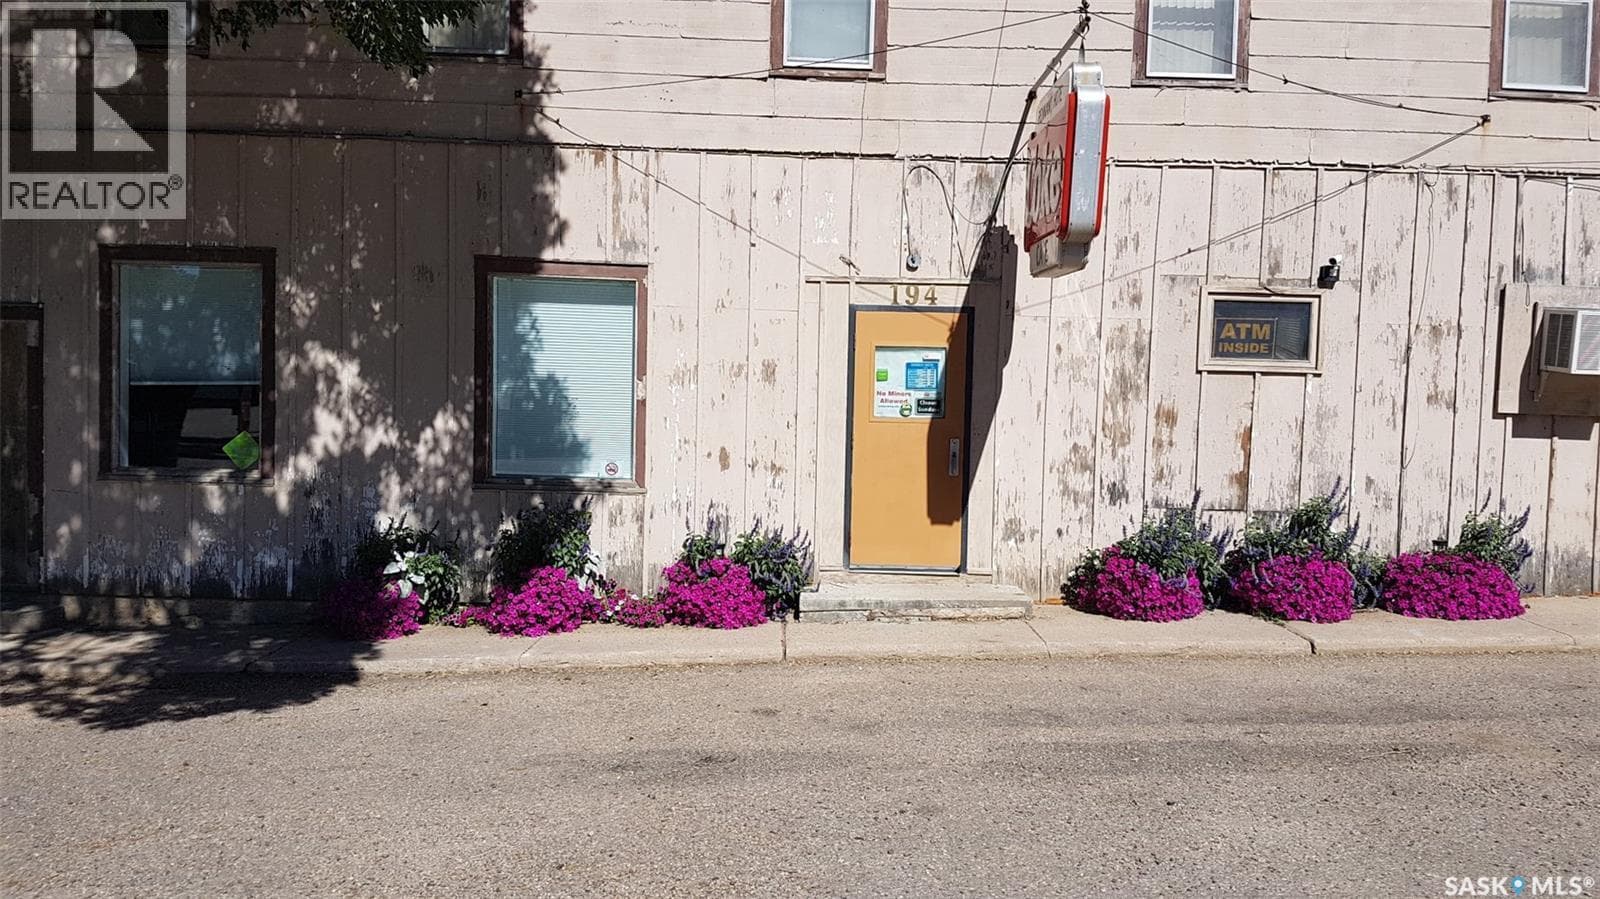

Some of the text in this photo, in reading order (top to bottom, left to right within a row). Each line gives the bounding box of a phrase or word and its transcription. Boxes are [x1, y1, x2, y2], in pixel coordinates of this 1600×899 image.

[889, 285, 938, 305] 194
[1220, 322, 1271, 340] ATM
[1219, 342, 1269, 354] INSIDE
